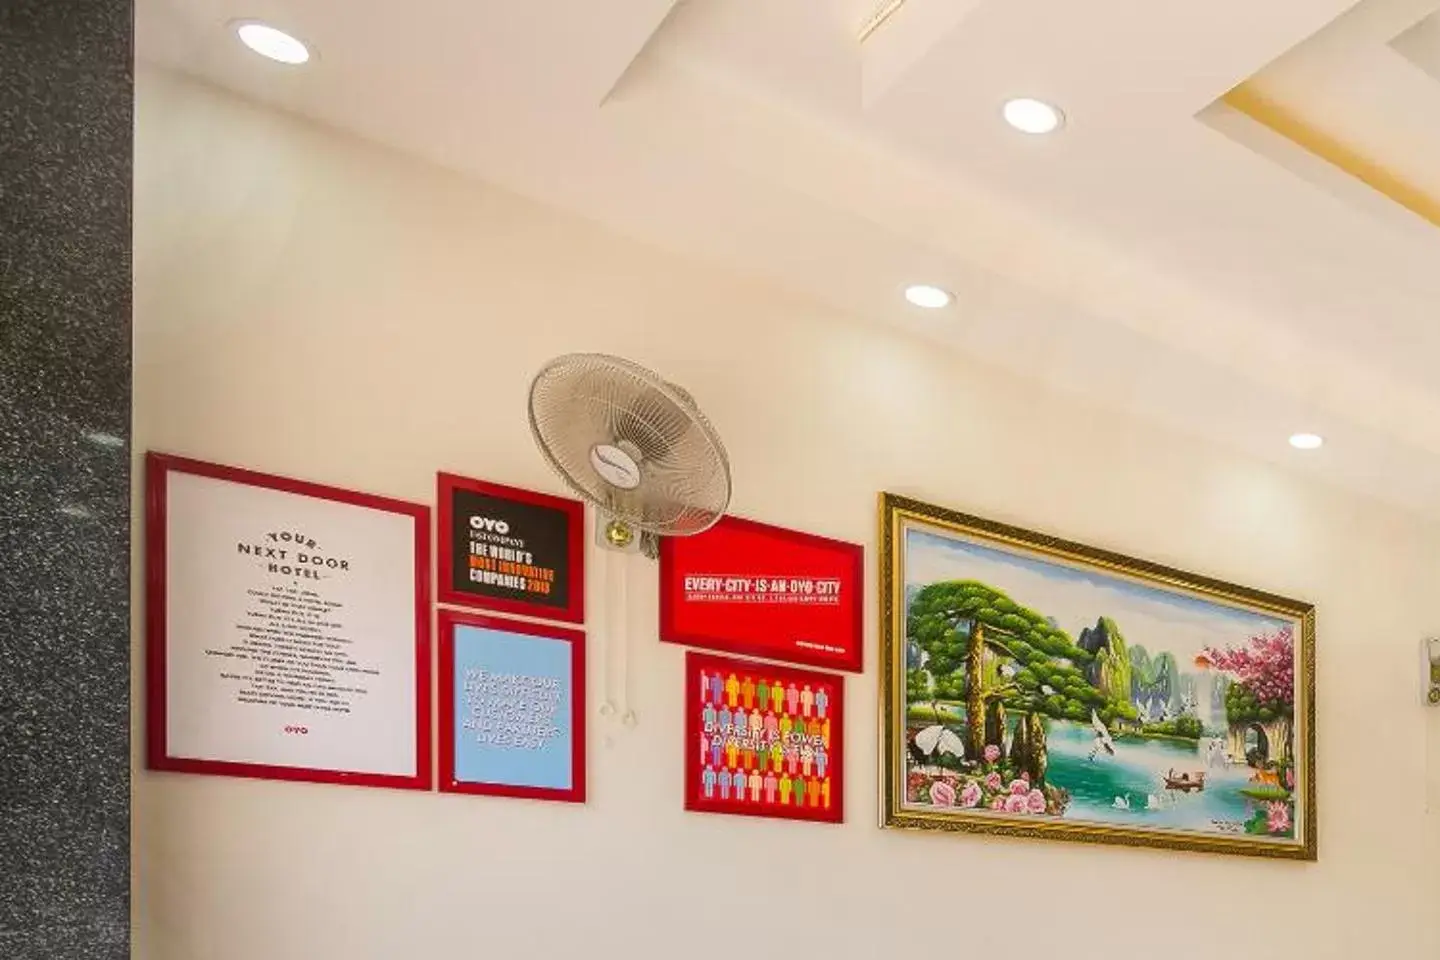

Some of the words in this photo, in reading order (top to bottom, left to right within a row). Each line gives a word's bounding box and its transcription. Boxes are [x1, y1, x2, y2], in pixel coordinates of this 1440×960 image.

[469, 516, 509, 534] OYO
[268, 531, 317, 549] YOUR
[237, 543, 287, 559] NEXT
[298, 553, 349, 571] DOOR
[469, 541, 488, 556] THE
[489, 545, 533, 565] WORLD'S
[268, 563, 320, 580] HOTEL
[469, 568, 526, 590] COMPANIES
[685, 577, 722, 591] EVERY
[725, 578, 751, 592] CITY
[756, 579, 767, 592] IS
[771, 579, 786, 593] AN
[790, 580, 813, 594] OYO
[816, 581, 841, 594] CITY
[704, 721, 766, 740] DIVERSITY
